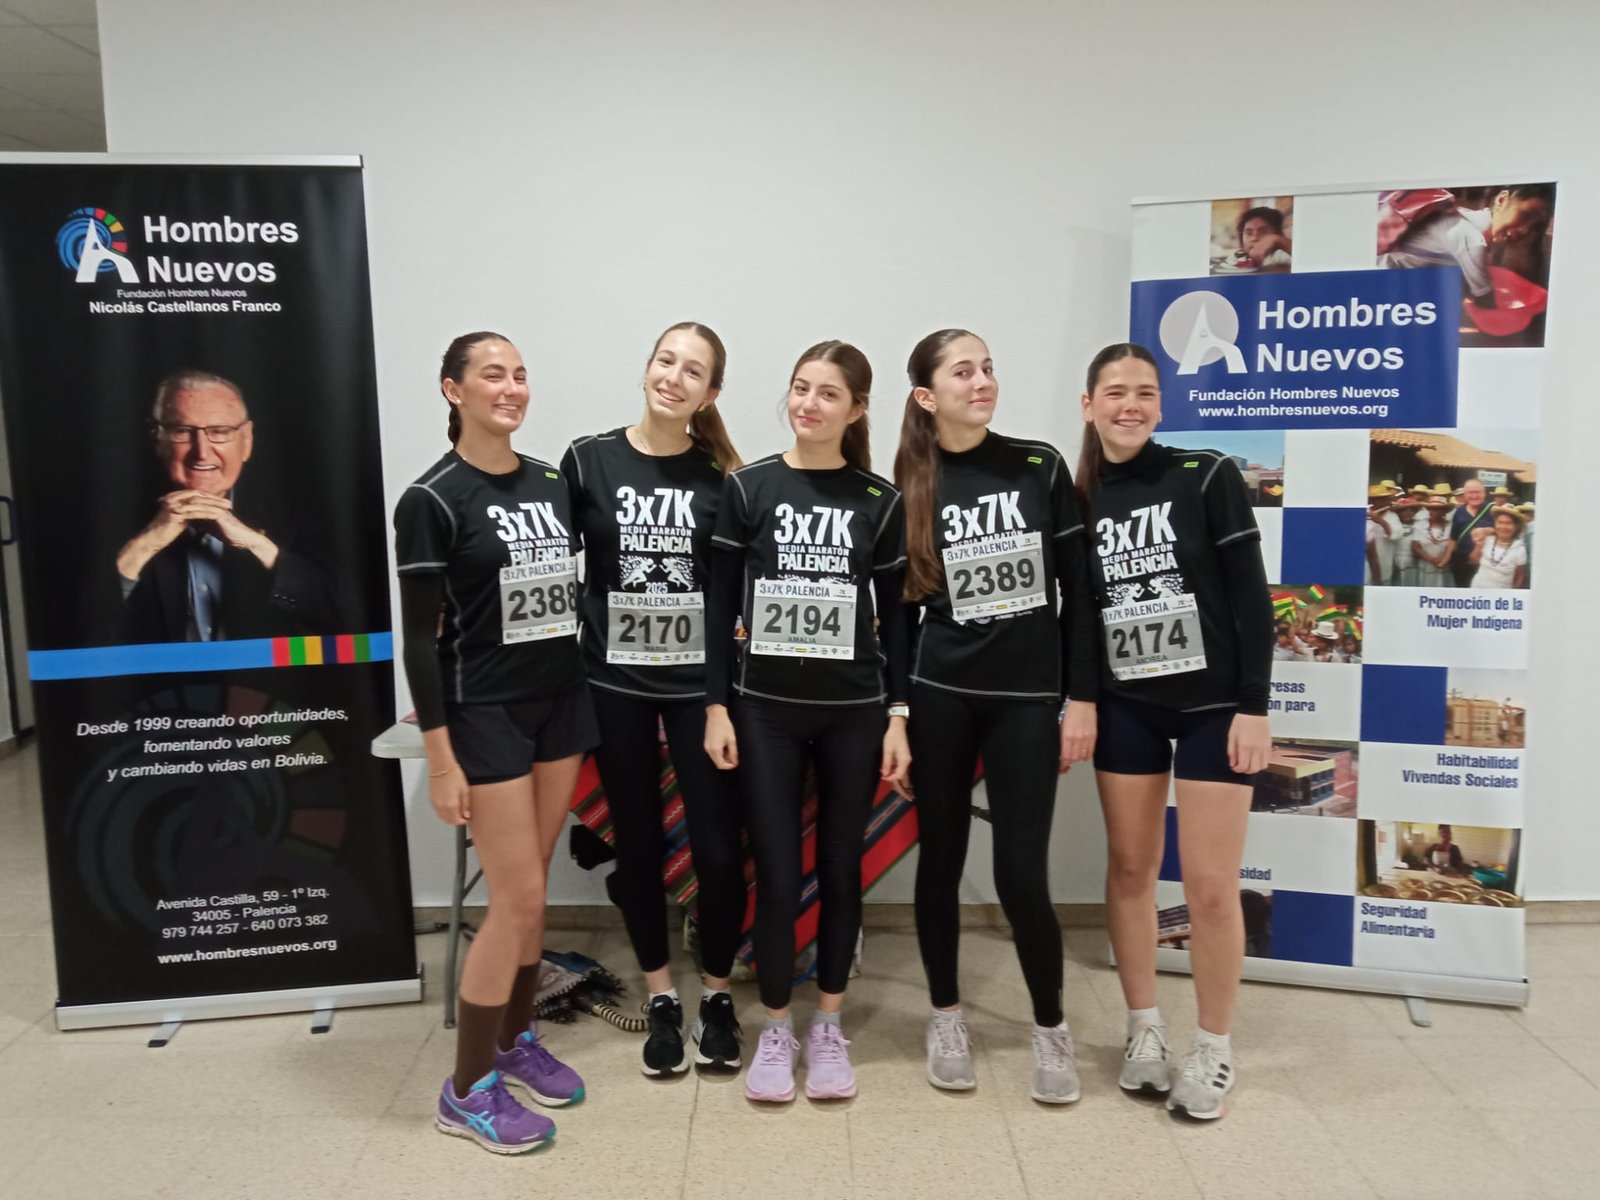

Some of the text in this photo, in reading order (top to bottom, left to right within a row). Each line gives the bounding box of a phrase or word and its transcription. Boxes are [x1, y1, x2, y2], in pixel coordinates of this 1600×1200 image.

[143, 215, 300, 244] Hombres
[147, 256, 277, 283] Nuevos
[117, 288, 248, 298] Fundación Hombres Nuevos
[89, 300, 281, 313] Nicolás Castellanos Franco
[1258, 297, 1437, 330] Hombres
[1257, 343, 1404, 372] Nuevos
[1189, 386, 1400, 401] Fundación Hombres Nuevos
[1198, 404, 1388, 417] www.hombresnuevos.org
[616, 486, 696, 528] 3x7K
[941, 491, 1027, 543] 3x7K
[486, 502, 569, 542] 3x7K
[620, 525, 692, 537] MEDIA MARATÓN
[773, 503, 855, 549] 3x7K
[1096, 501, 1177, 557] 3x7K
[620, 534, 693, 554] PALENCIA
[777, 544, 850, 556] MEDIA MARATÓN
[947, 548, 971, 561] 3x7K
[972, 540, 1018, 556] PALENCIA
[1101, 543, 1173, 565] MEDIA MARATÓN
[503, 568, 527, 580] 3x7K
[528, 562, 567, 577] PALENCIA
[777, 553, 850, 574] PALENCIA
[1103, 552, 1179, 583] PALENCIA
[645, 582, 668, 594] 2025
[953, 558, 1035, 600] 2389
[613, 595, 636, 605] 3x7K
[637, 597, 681, 607] PALENCIA
[759, 584, 784, 595] 3x7K
[785, 585, 830, 597] PALENCIA
[508, 581, 577, 622] 2388
[1125, 602, 1169, 618] PALENCIA
[1419, 595, 1523, 610] Promoción de la
[618, 613, 691, 644] 2170
[763, 603, 841, 637] 2194
[1427, 614, 1523, 631] Mujer Indígena
[1112, 618, 1188, 659] 2174
[1285, 700, 1316, 712] para
[76, 708, 349, 736] Desde 1999 creando oportunidades,
[143, 734, 291, 753] fomentando valores
[107, 752, 328, 782] y cambiando vidas en Bolivia.
[1437, 753, 1519, 769] Habitabilidad
[1465, 773, 1518, 788] Sociales
[156, 897, 207, 910] Avenida
[210, 893, 260, 906] Castilla,
[262, 890, 279, 902] 59
[307, 887, 330, 899] Izq.
[192, 909, 232, 922] 34005
[242, 903, 297, 918] Palencia
[1361, 902, 1428, 919] Seguridad
[162, 926, 187, 939] 979
[189, 925, 213, 936] 744
[216, 923, 239, 934] 257
[251, 919, 275, 931] 640
[278, 917, 302, 929] 073
[305, 914, 329, 926] 382
[1360, 920, 1435, 939] Alimentaria
[157, 940, 337, 964] www.hombresnuevos.org
